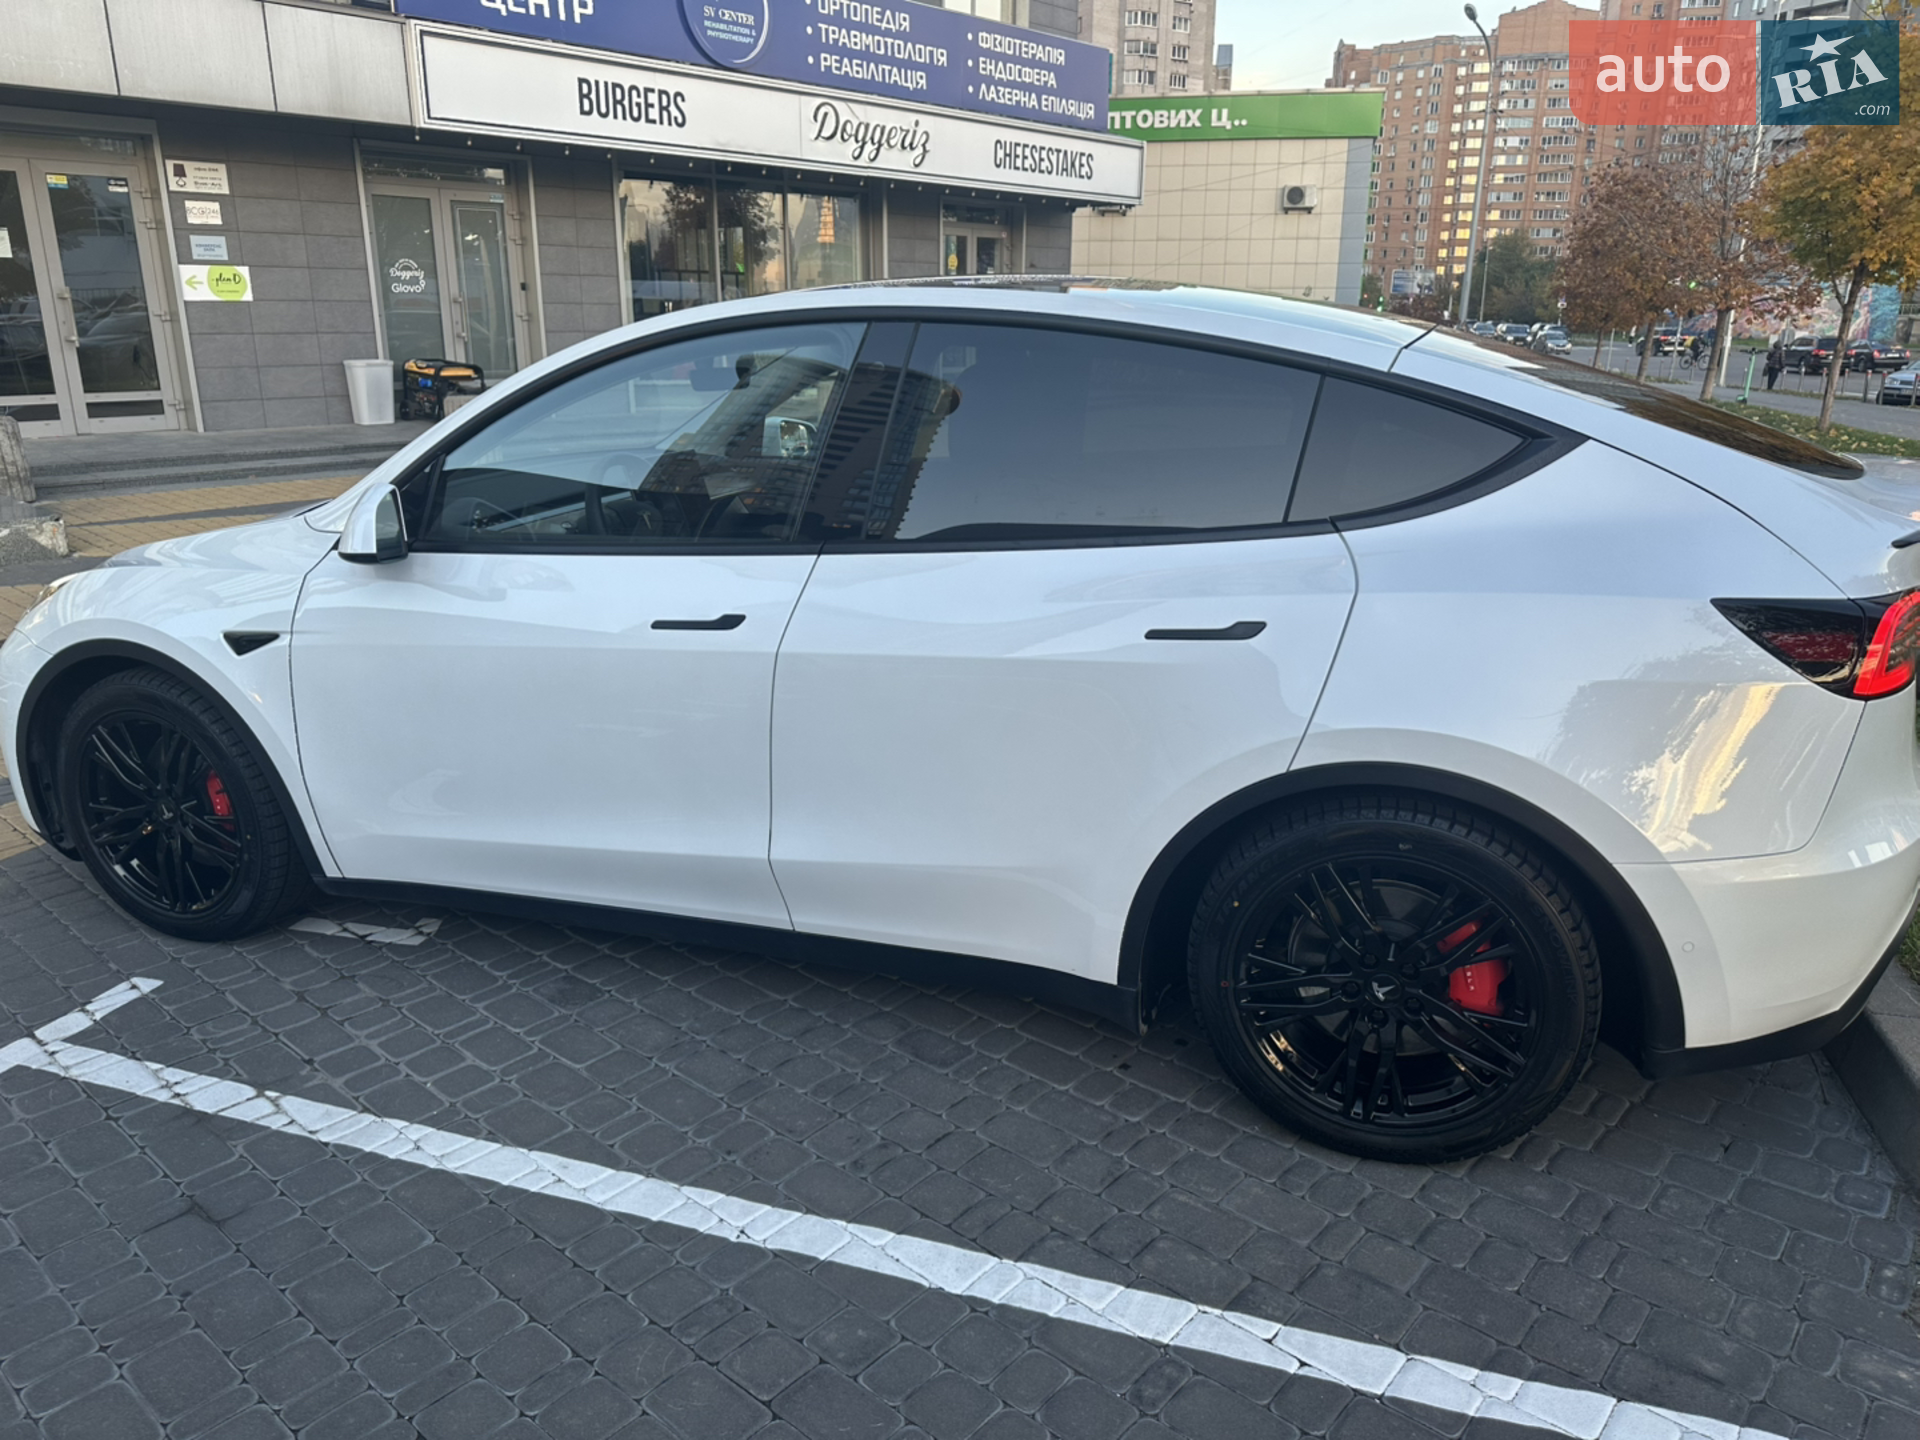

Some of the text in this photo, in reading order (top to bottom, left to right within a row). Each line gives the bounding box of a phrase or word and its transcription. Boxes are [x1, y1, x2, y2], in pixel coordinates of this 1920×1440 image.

[703, 20, 750, 35] REHABILITATION
[718, 8, 755, 26] CENTER
[817, 0, 910, 32] ОРТОПЕДІЯ
[706, 29, 754, 44] PHYSIOTHERAPY
[817, 22, 948, 67] ТРАВМОТОЛОГІЯ
[978, 31, 1065, 66] ФІЗІОТЕРАПІЯ
[820, 52, 927, 91] РЕАБІЛІТАЦІЯ
[979, 56, 1057, 88] ЕНДОСФЕРА
[577, 76, 687, 129] BURGERS
[978, 82, 1095, 120] ЛАЗЕРНА ЕПІЛЯЦІЯ
[812, 101, 931, 168] Doggeriz
[994, 139, 1094, 180] CHEESESTAKES
[391, 282, 423, 293] Glovo
